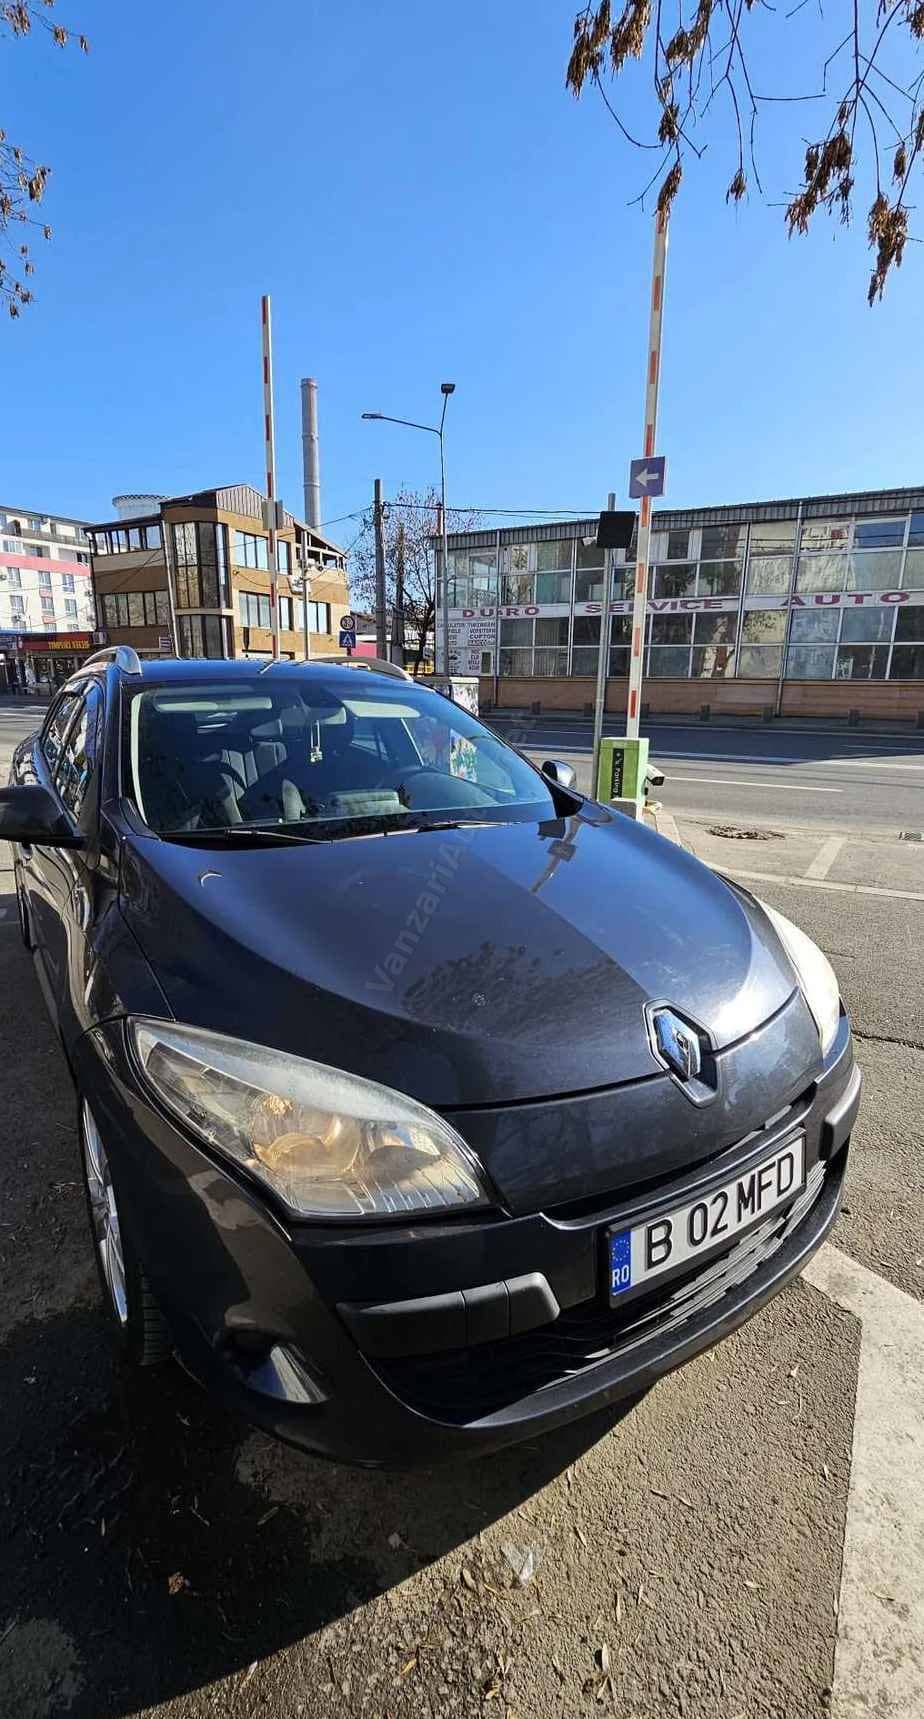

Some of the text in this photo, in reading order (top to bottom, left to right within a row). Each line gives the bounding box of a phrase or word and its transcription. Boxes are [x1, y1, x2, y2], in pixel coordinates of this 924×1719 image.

[585, 599, 723, 614] SEVICE
[780, 591, 910, 606] AUTO
[644, 1151, 794, 1272] B 02 MFD
[612, 1264, 630, 1289] RO
